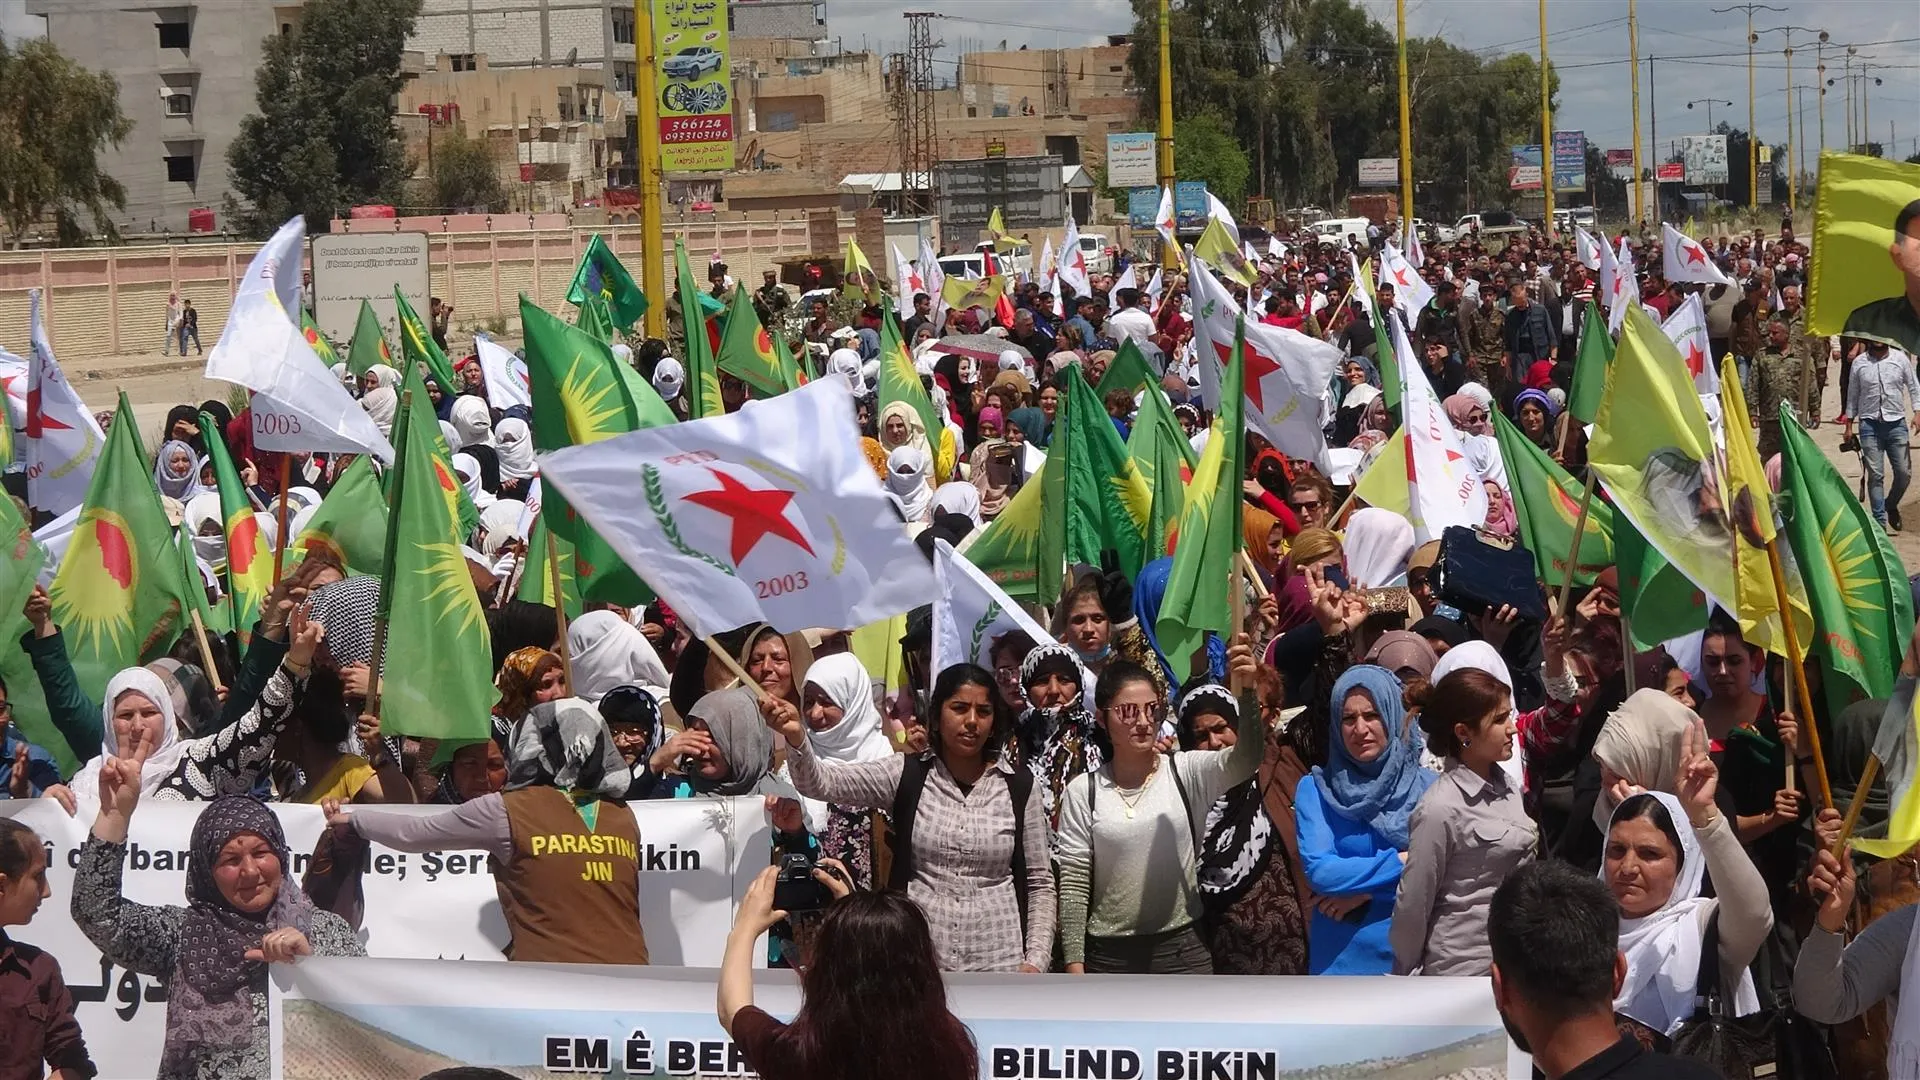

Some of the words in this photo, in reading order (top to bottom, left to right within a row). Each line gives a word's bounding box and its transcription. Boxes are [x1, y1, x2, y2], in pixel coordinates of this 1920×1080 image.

[691, 2, 717, 14] جميع
[671, 16, 713, 29] السيارات
[672, 119, 721, 131] 366124
[665, 129, 728, 141] 0933103196
[255, 413, 302, 435] 2003
[756, 571, 809, 599] 2003
[581, 861, 613, 881] JIN
[546, 1037, 609, 1069] EM
[626, 1030, 652, 1070] Ê
